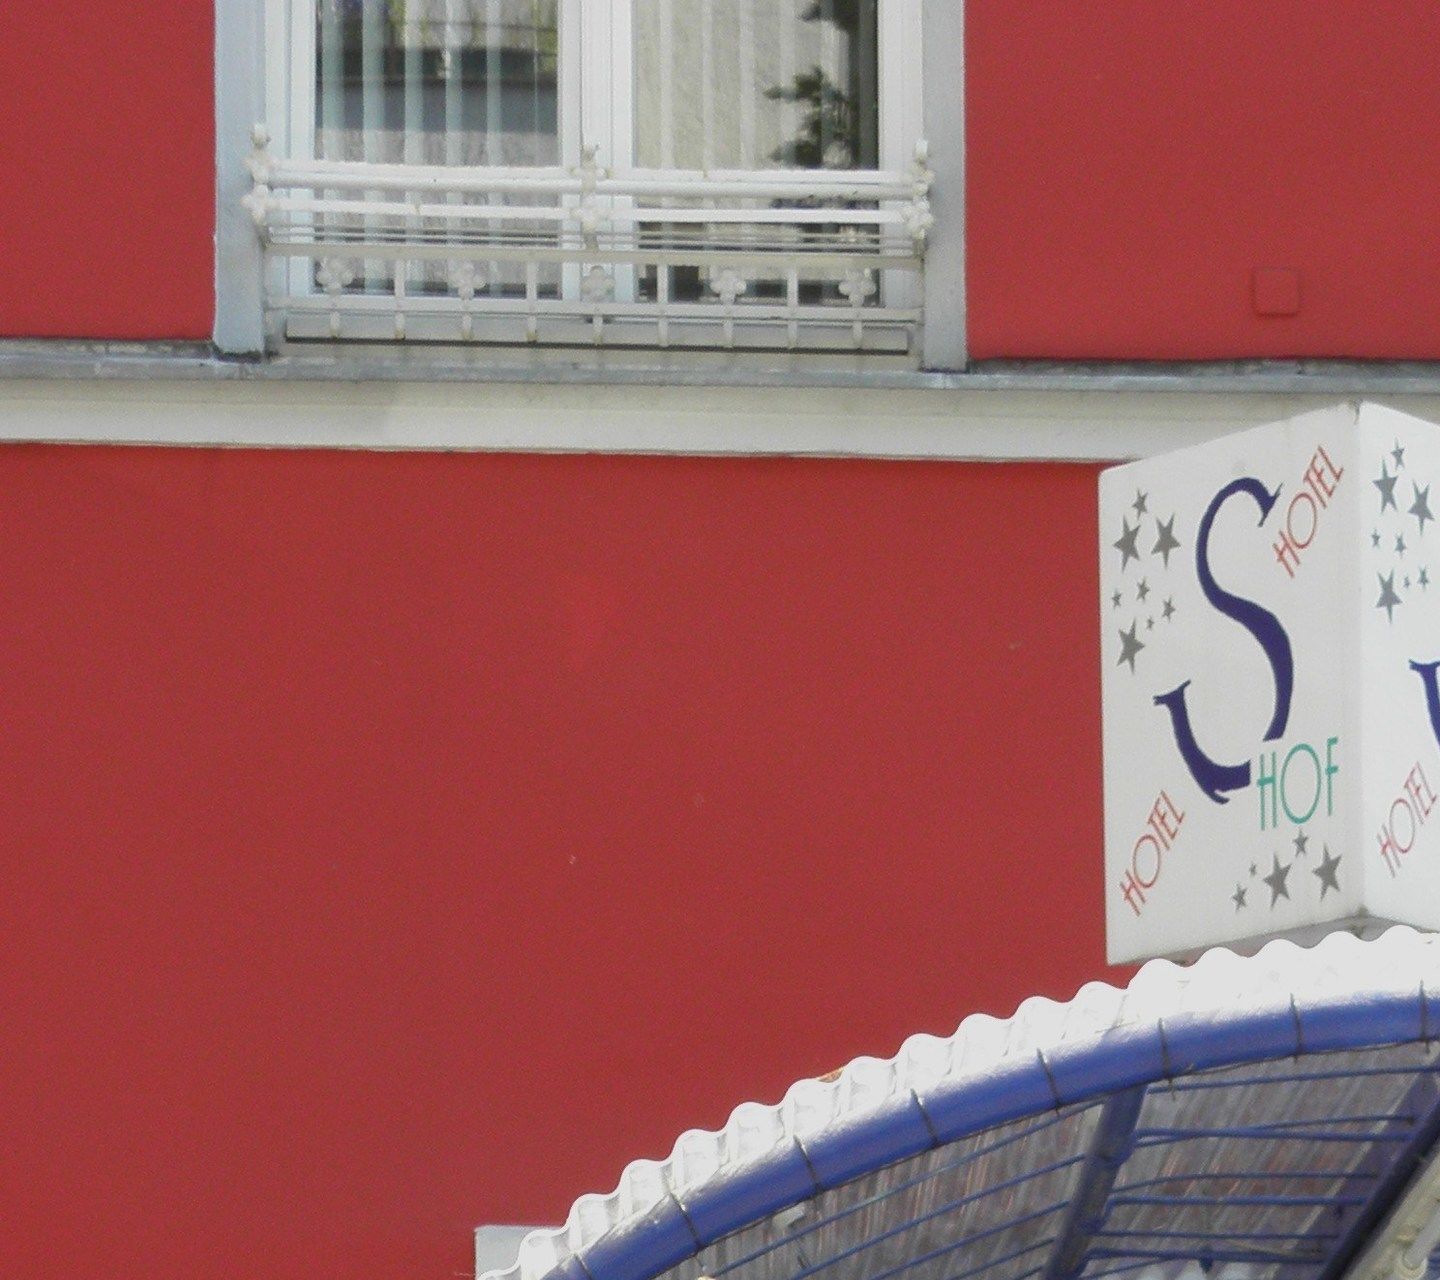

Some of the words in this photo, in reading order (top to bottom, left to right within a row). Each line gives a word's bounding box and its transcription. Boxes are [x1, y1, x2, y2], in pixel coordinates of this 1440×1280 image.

[1273, 446, 1344, 578] HOTEL
[1257, 736, 1339, 831] HOF
[1376, 762, 1438, 878] HOTEL
[1119, 790, 1186, 917] HOTEL
